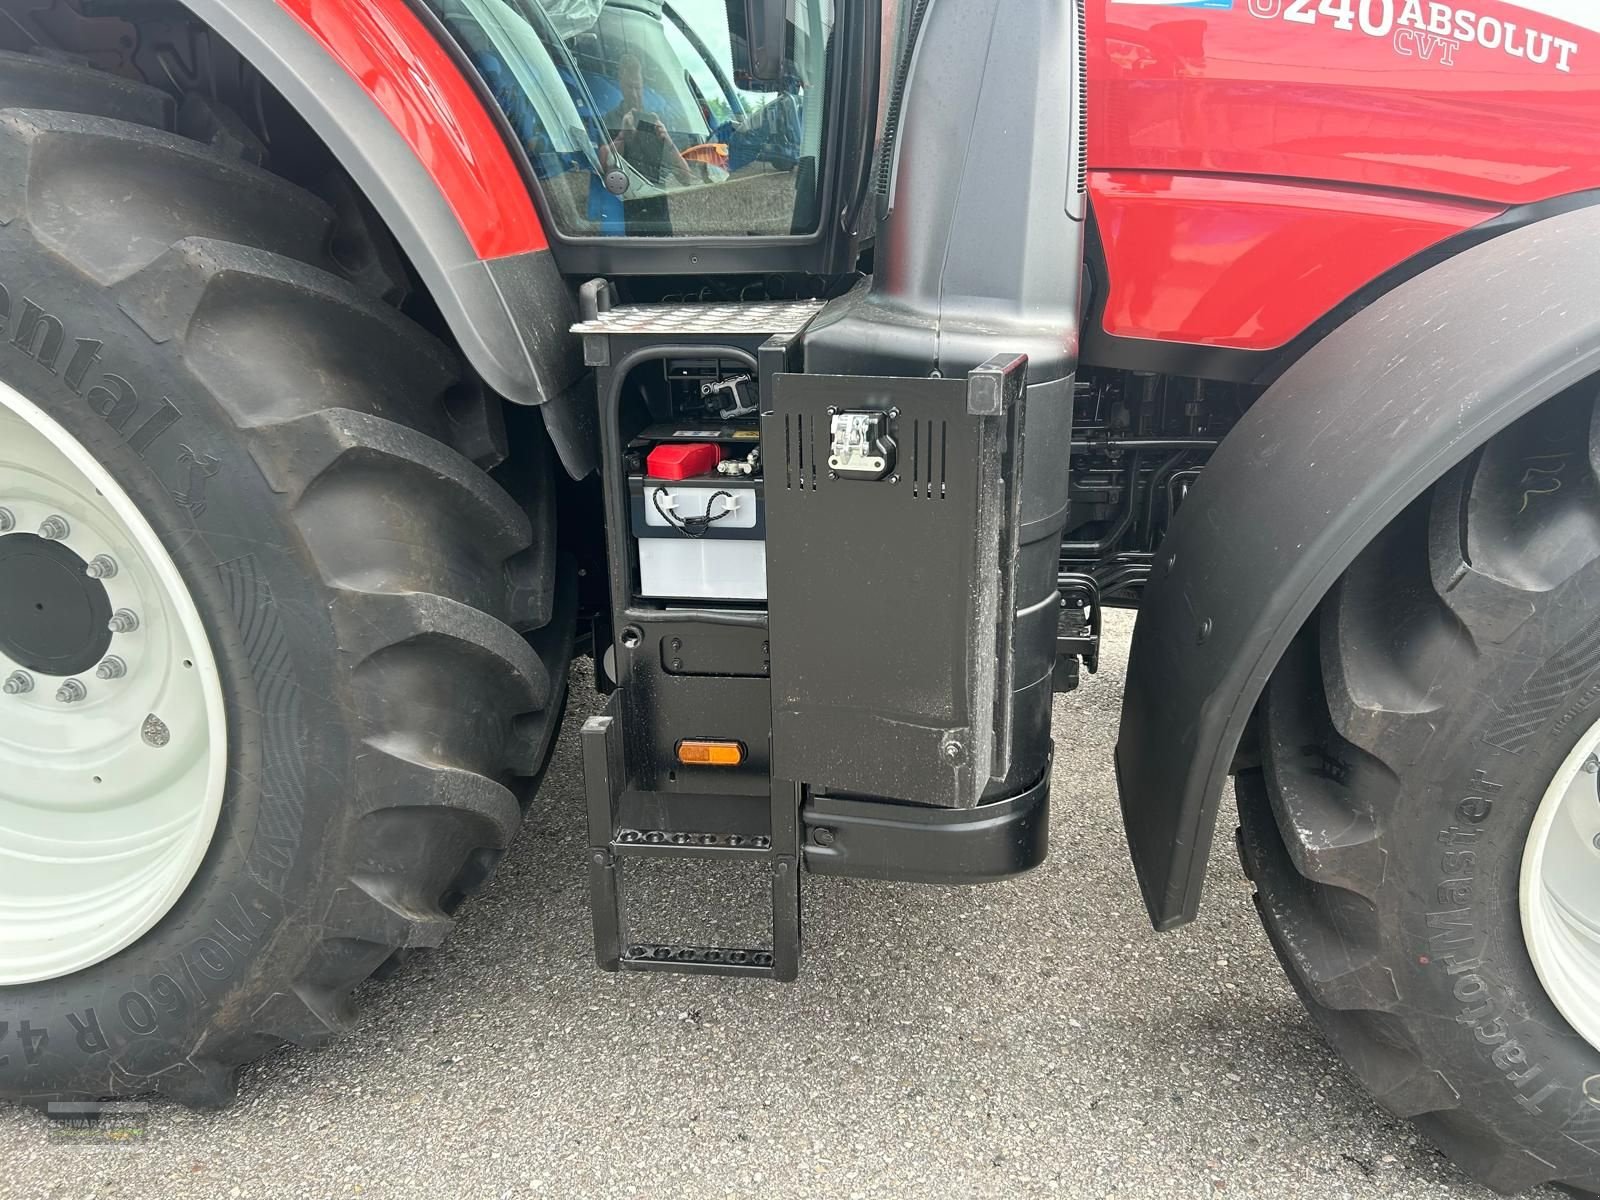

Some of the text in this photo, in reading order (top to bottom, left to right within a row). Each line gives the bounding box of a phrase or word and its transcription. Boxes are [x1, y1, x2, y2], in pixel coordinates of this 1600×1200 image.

[1394, 28, 1459, 66] CVT
[1397, 0, 1578, 73] ABSOLUT
[1425, 767, 1562, 1117] TractorMaster
[65, 1007, 111, 1057] R
